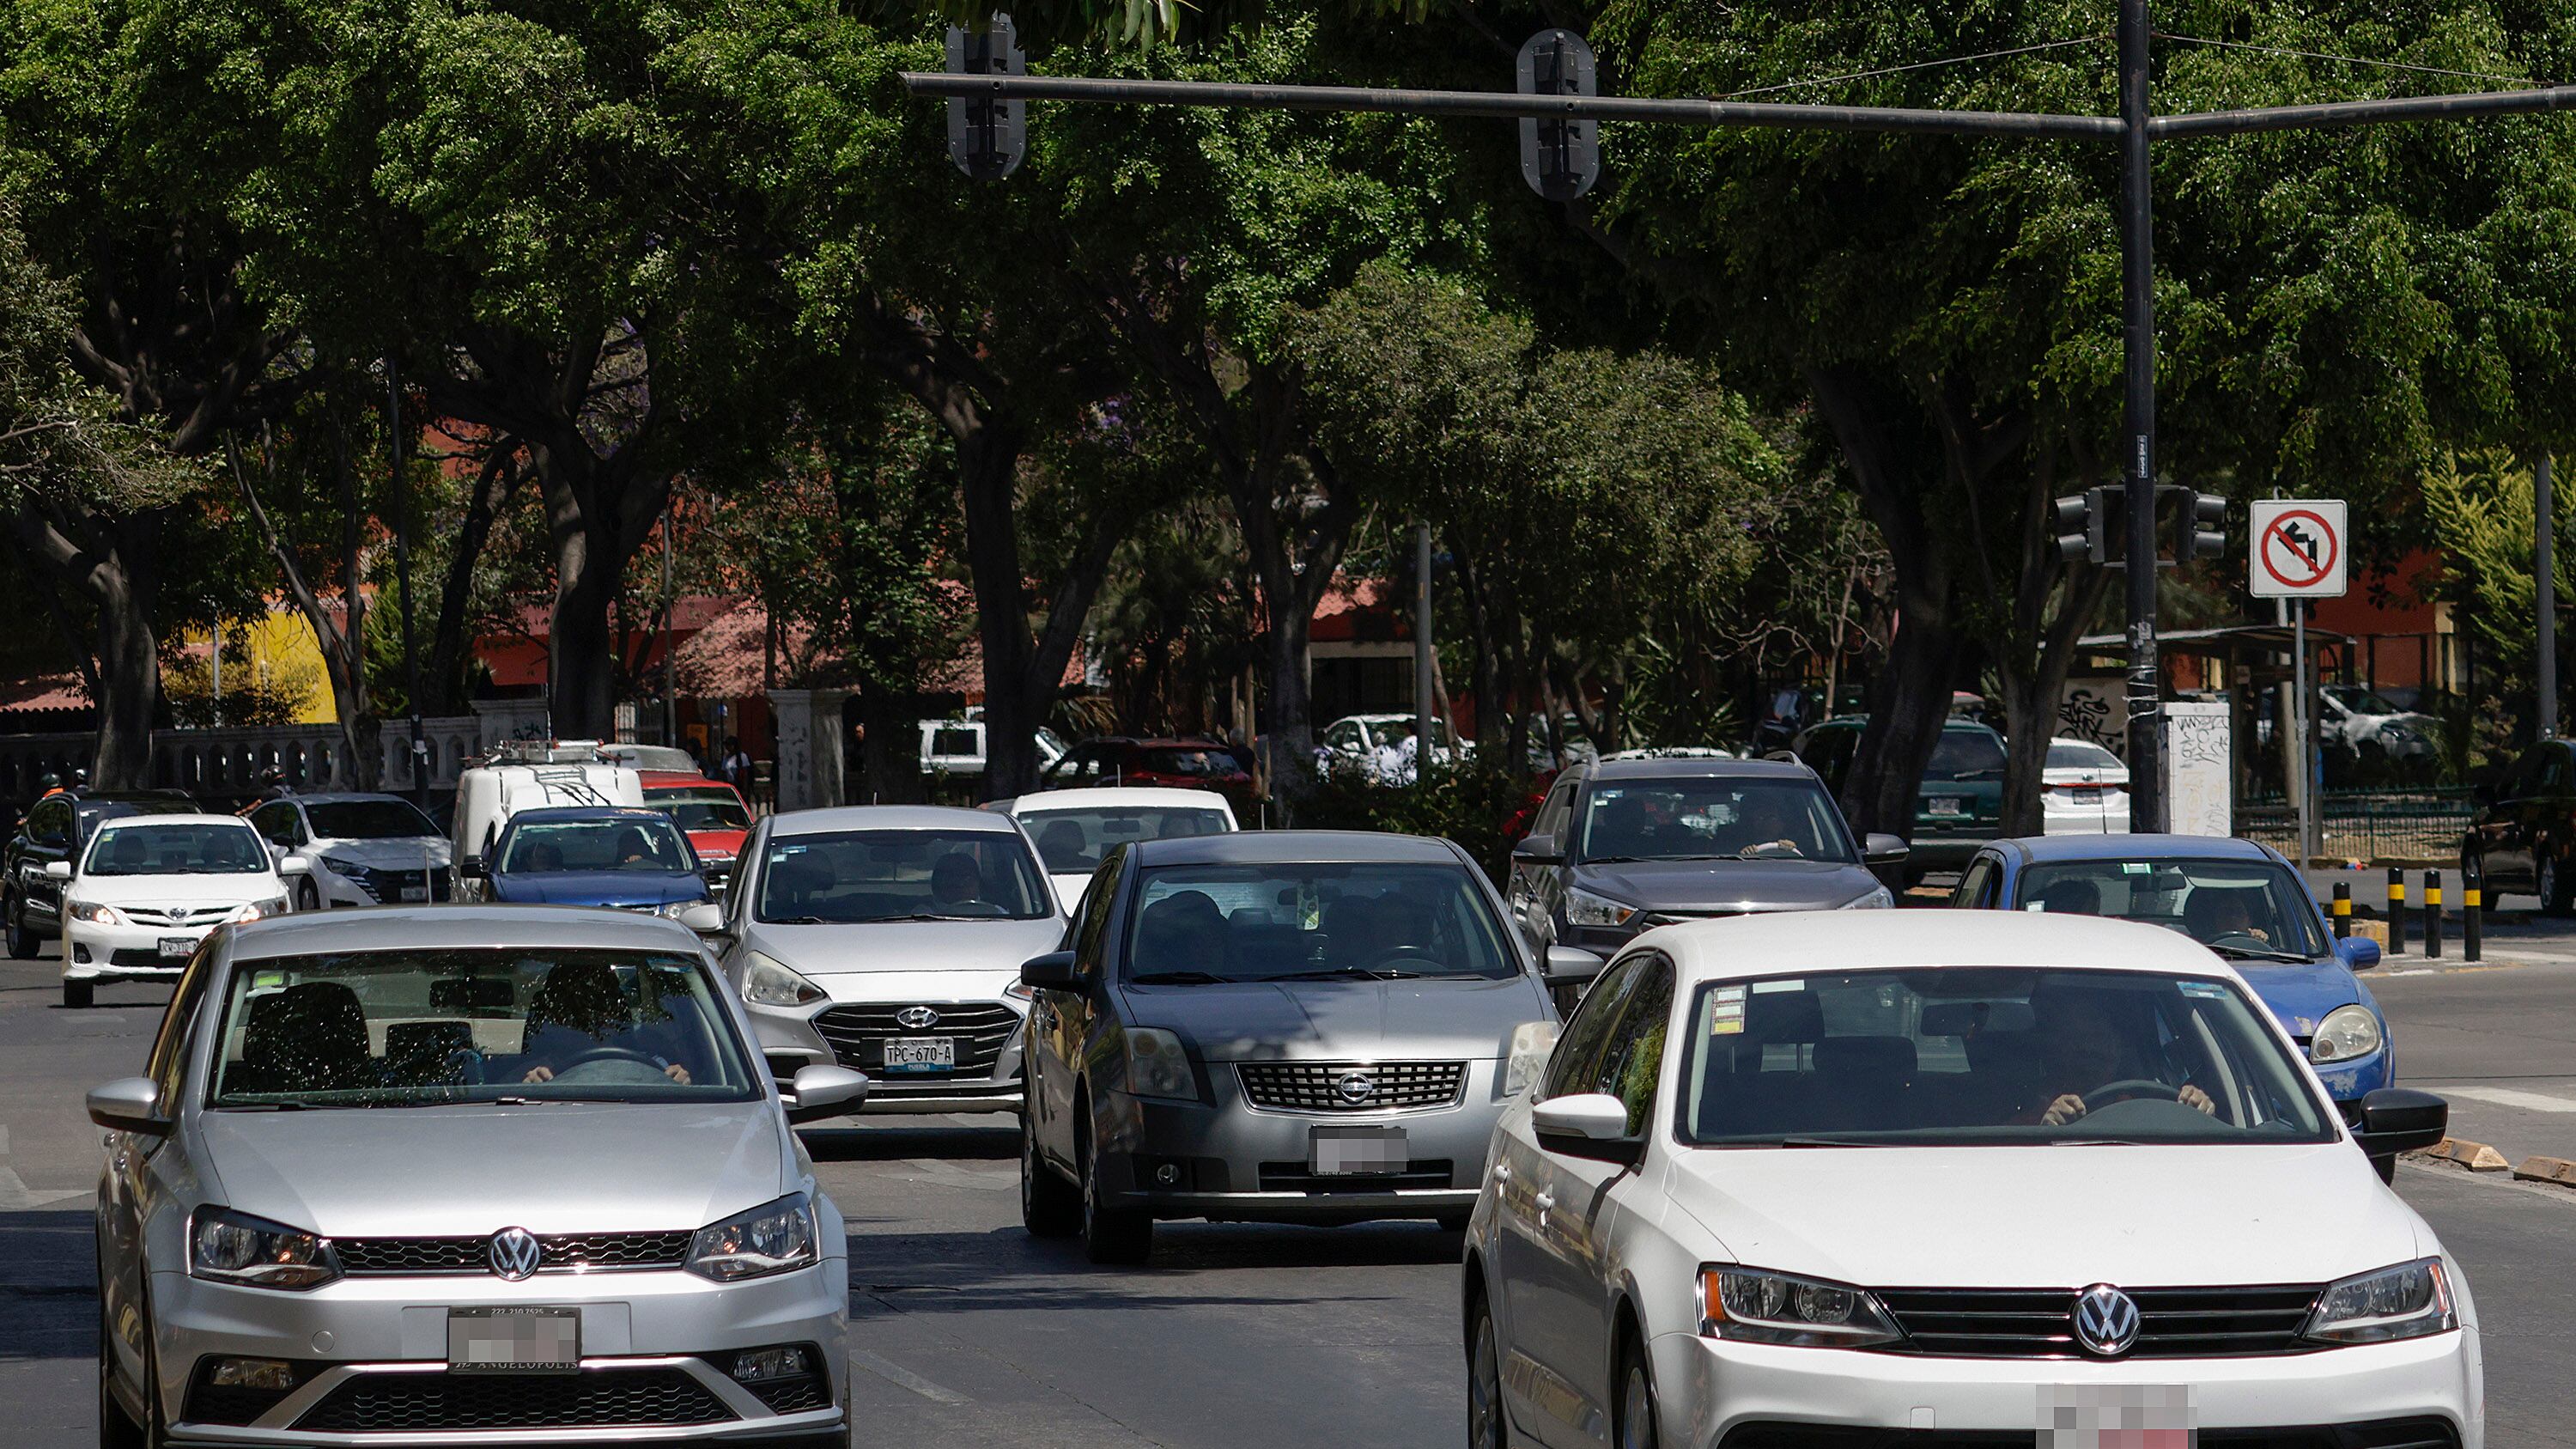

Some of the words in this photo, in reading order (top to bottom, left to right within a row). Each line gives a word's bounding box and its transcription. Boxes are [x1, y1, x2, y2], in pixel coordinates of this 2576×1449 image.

[887, 1044, 951, 1062] TPC-670-A
[492, 1231, 538, 1275] VW
[2078, 1288, 2136, 1342] VW
